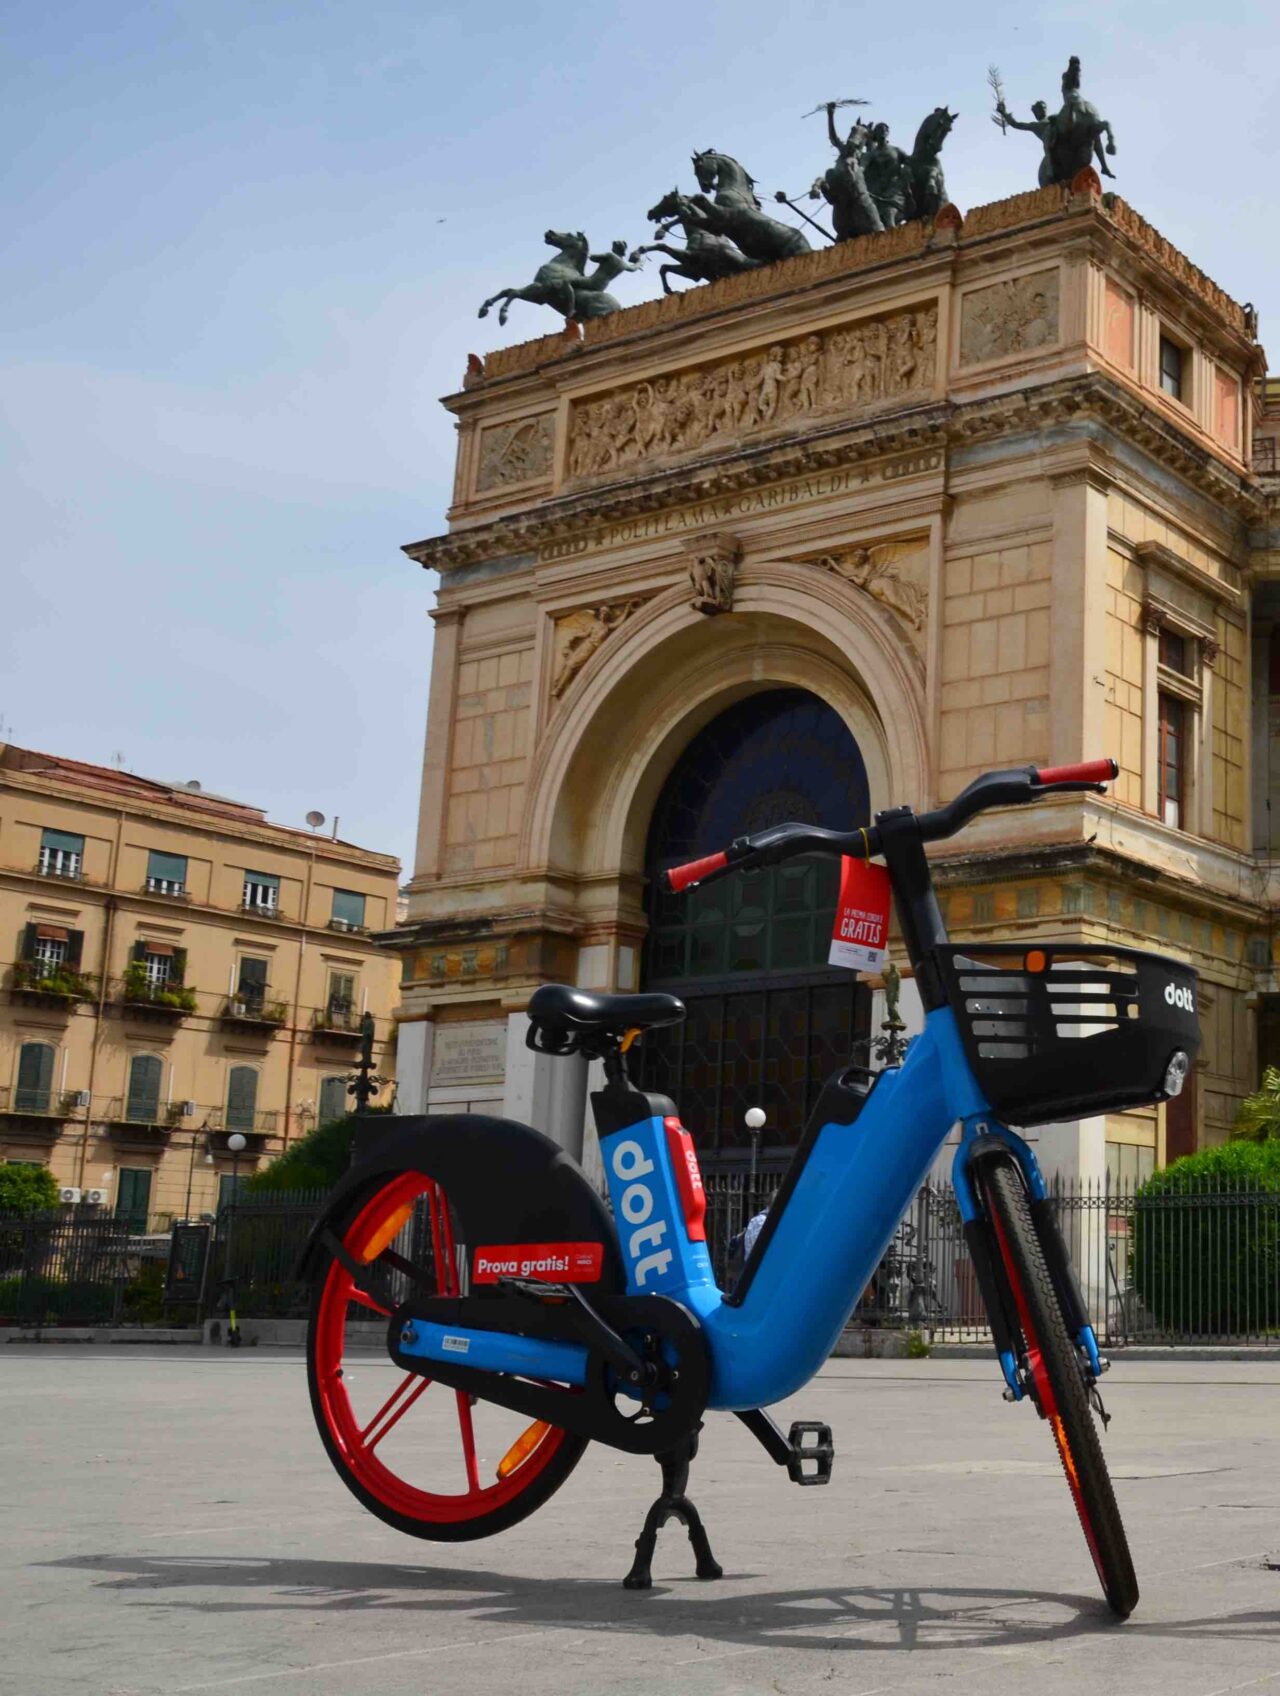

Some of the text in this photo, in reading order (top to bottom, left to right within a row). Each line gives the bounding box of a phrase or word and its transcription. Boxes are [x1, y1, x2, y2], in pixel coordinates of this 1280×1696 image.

[609, 471, 851, 545] POLITEAMA GARIBALDI
[840, 918, 882, 944] GRATIS
[1163, 982, 1195, 1013] dott
[684, 1149, 703, 1190] dott
[612, 1139, 674, 1287] dott
[477, 1254, 569, 1277] Prova gratis!
